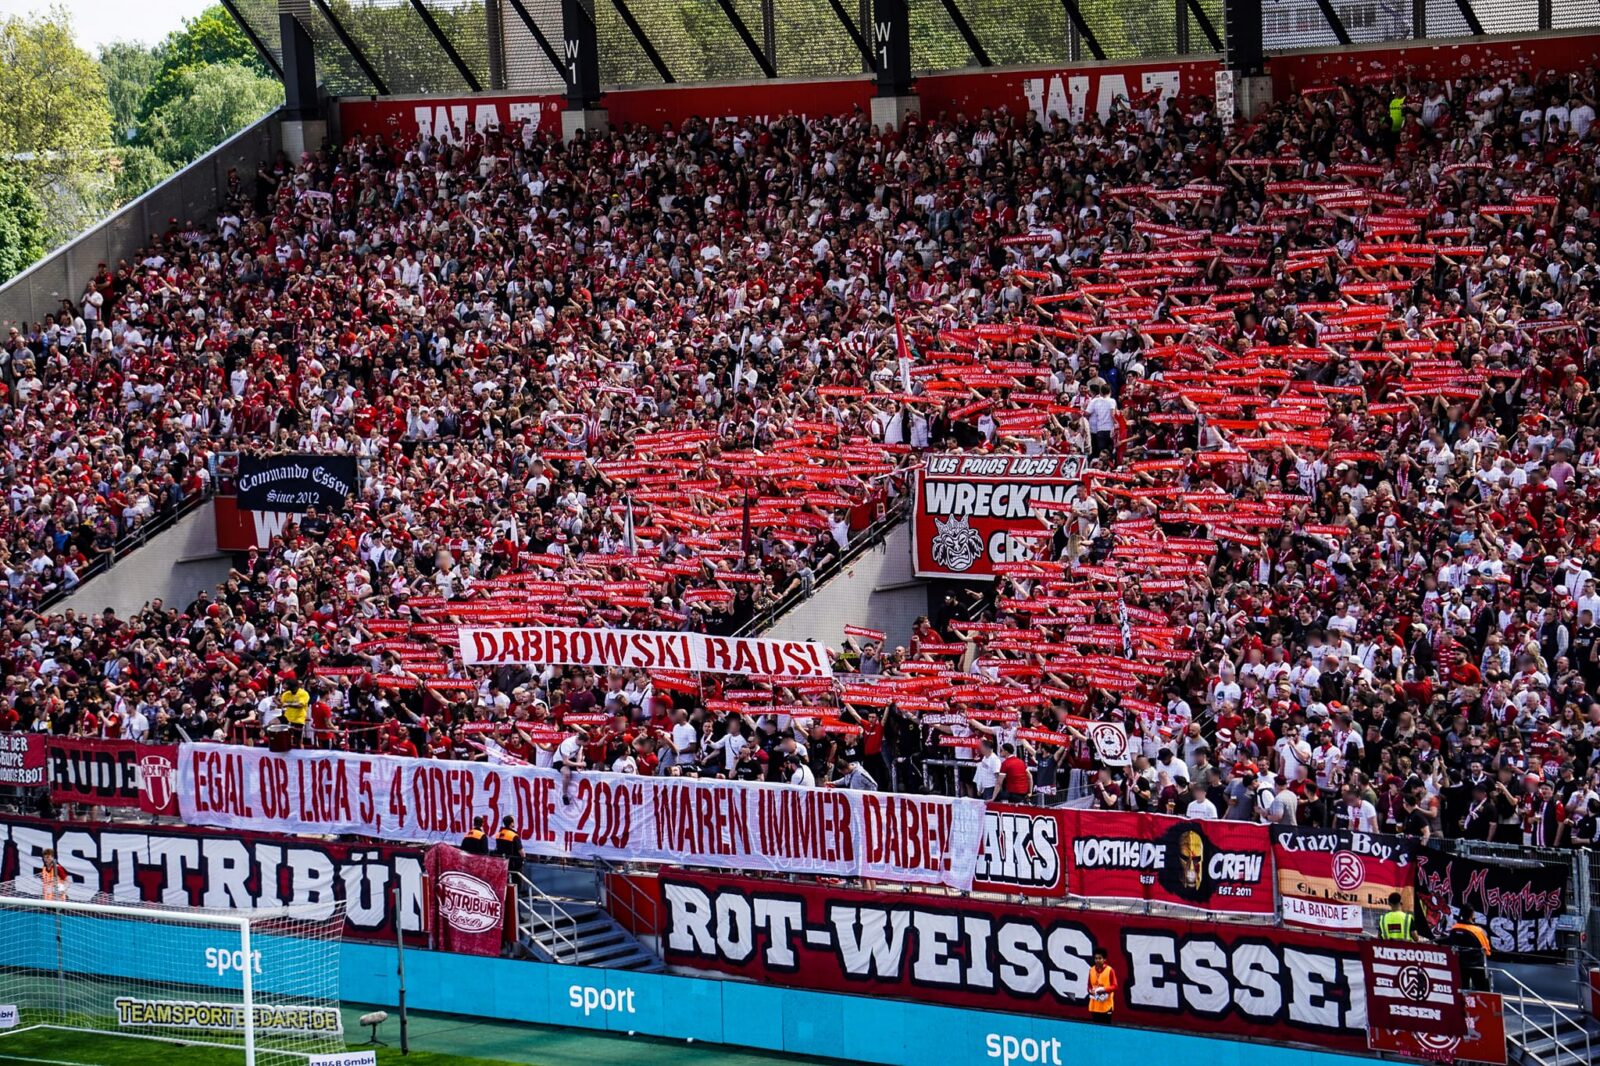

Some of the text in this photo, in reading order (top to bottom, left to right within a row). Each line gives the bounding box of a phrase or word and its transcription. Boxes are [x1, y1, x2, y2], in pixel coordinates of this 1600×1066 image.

[874, 21, 892, 42] W
[564, 40, 580, 58] W
[879, 46, 888, 69] 1
[569, 62, 577, 85] 1
[929, 458, 959, 474] LOS
[1009, 458, 1058, 476] LOCOS
[239, 463, 349, 497] Commando Essen
[266, 489, 320, 504] Since 2012
[472, 631, 824, 676] DABROWSKI RAUS!
[11, 736, 28, 751] DER
[51, 748, 139, 798] RUDE
[193, 751, 252, 818] EGAL
[259, 756, 290, 819] OB
[297, 758, 352, 822] LIGA
[359, 761, 381, 834] 5,
[389, 766, 407, 828] 4
[412, 766, 475, 833] ODER
[482, 771, 501, 837] 3
[513, 776, 556, 841] DIE
[653, 785, 752, 855] WAREN
[758, 788, 854, 862] IMMER
[1073, 840, 1166, 869] NORTHSIDE
[1207, 853, 1263, 882] CREW
[1218, 886, 1252, 896] EST. 2011
[1293, 900, 1348, 920] LA BANDA E
[664, 883, 1093, 1000] ROT-WEISS
[1372, 946, 1448, 966] KATEGORIE
[1376, 977, 1393, 987] SEIT
[569, 985, 635, 1016] sport
[1389, 1004, 1442, 1021] ESSEN
[986, 1033, 1062, 1066] sport
[344, 1057, 374, 1066] GmbH
